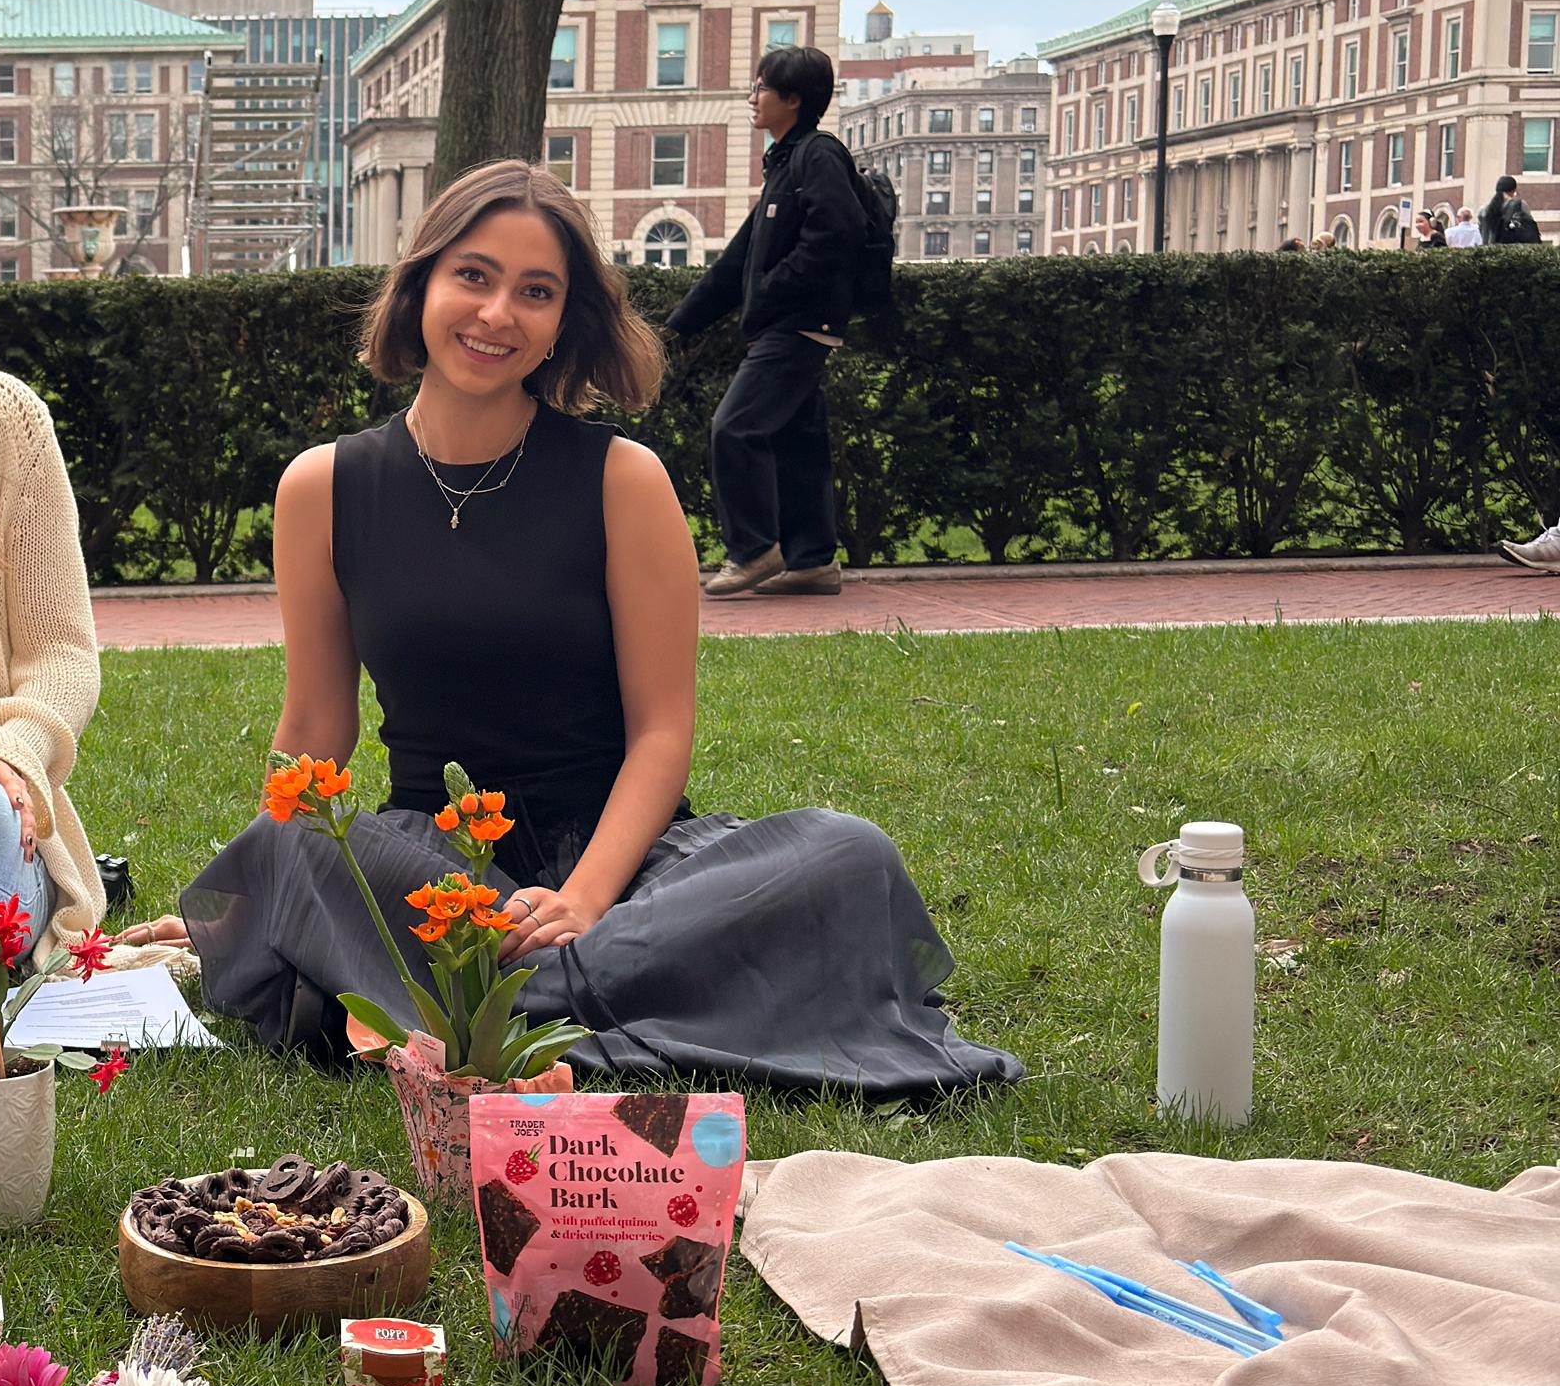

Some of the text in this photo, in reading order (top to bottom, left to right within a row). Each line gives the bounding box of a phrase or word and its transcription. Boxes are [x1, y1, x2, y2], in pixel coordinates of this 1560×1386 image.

[509, 1119, 545, 1129] TRADER
[548, 1134, 618, 1157] Dark
[548, 1160, 685, 1184] Chocolate
[549, 1187, 619, 1210] Bark
[551, 1215, 658, 1229] with puffed quinoa
[550, 1229, 665, 1243] & dried raspberries
[375, 1328, 409, 1341] POPPY
